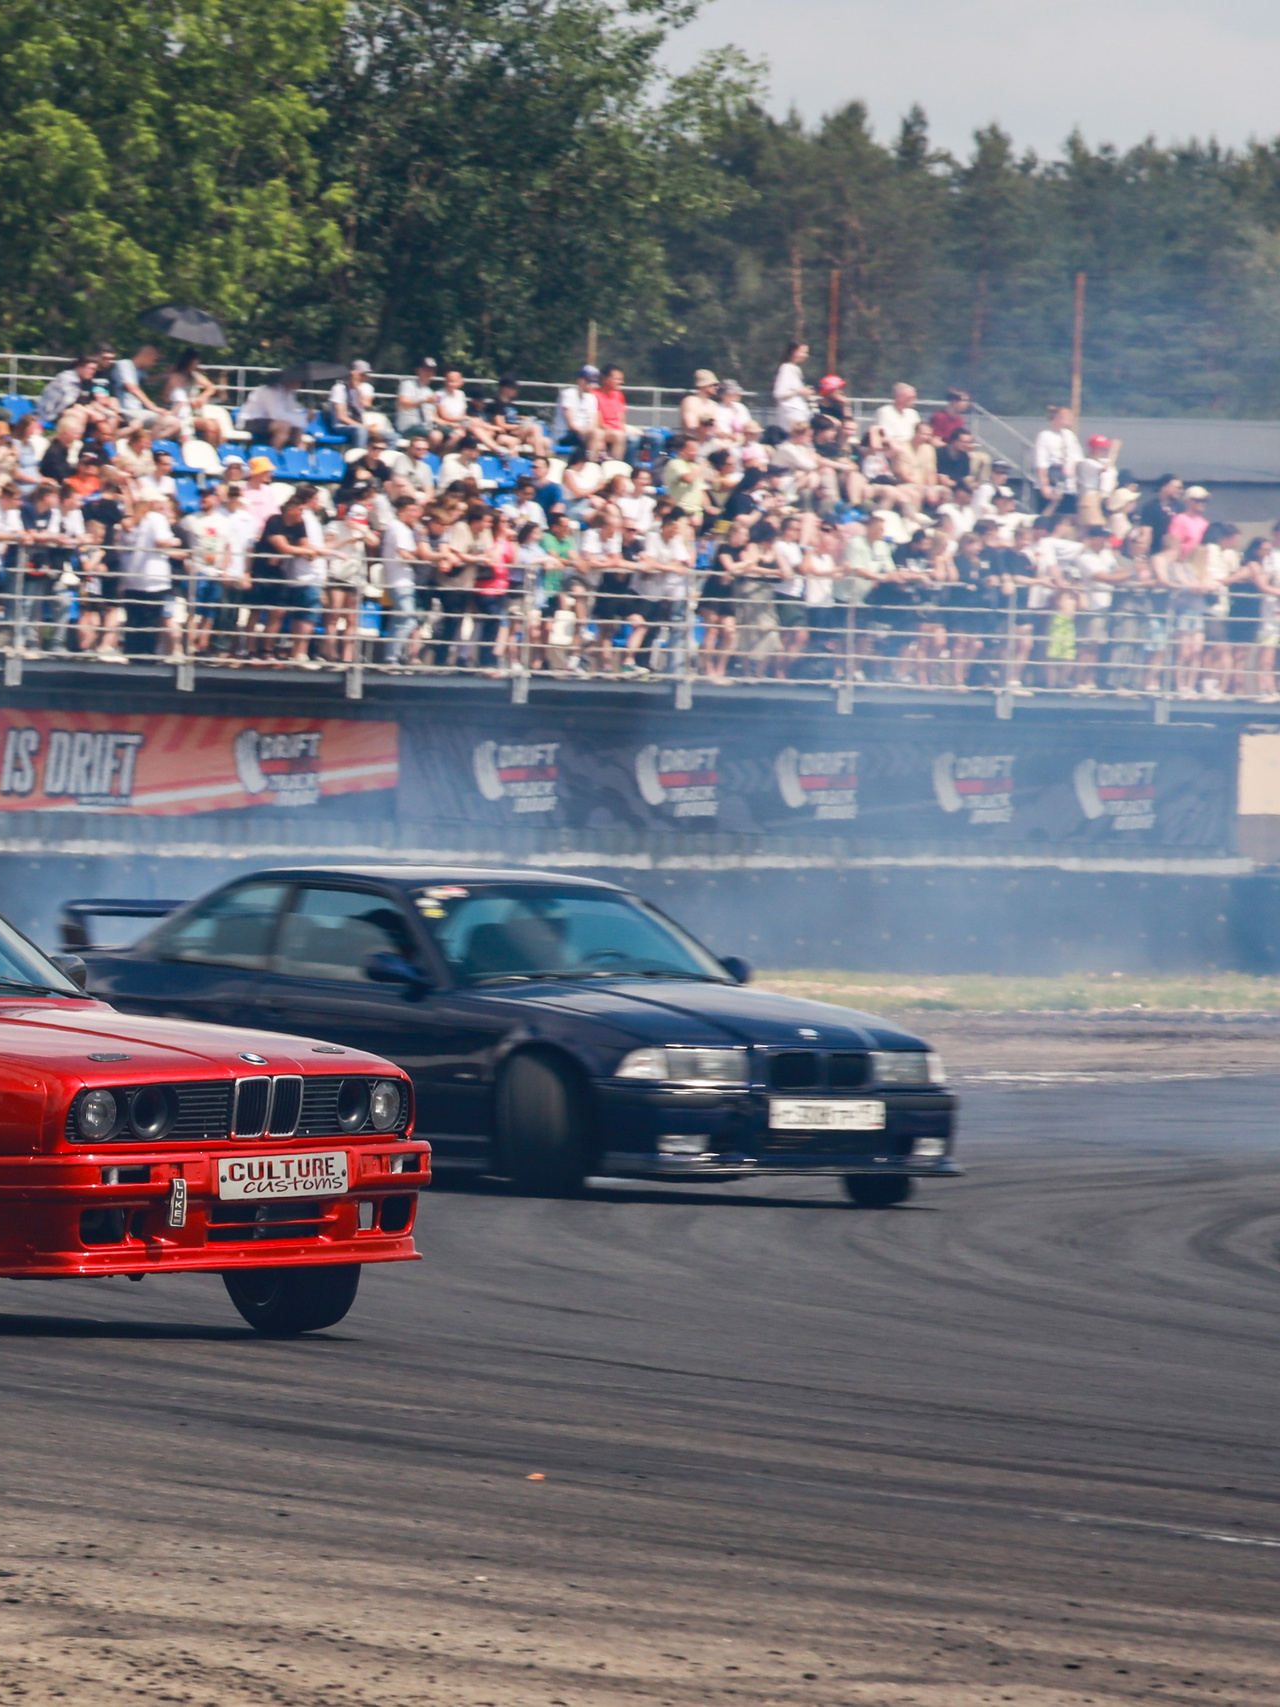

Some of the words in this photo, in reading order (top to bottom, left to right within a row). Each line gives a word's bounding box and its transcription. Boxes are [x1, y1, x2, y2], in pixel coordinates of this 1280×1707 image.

[0, 728, 41, 795] IS
[44, 730, 144, 796] DRIFT
[228, 1157, 336, 1182] CULTURE
[242, 1176, 343, 1194] customs
[173, 1181, 184, 1218] LUKE
